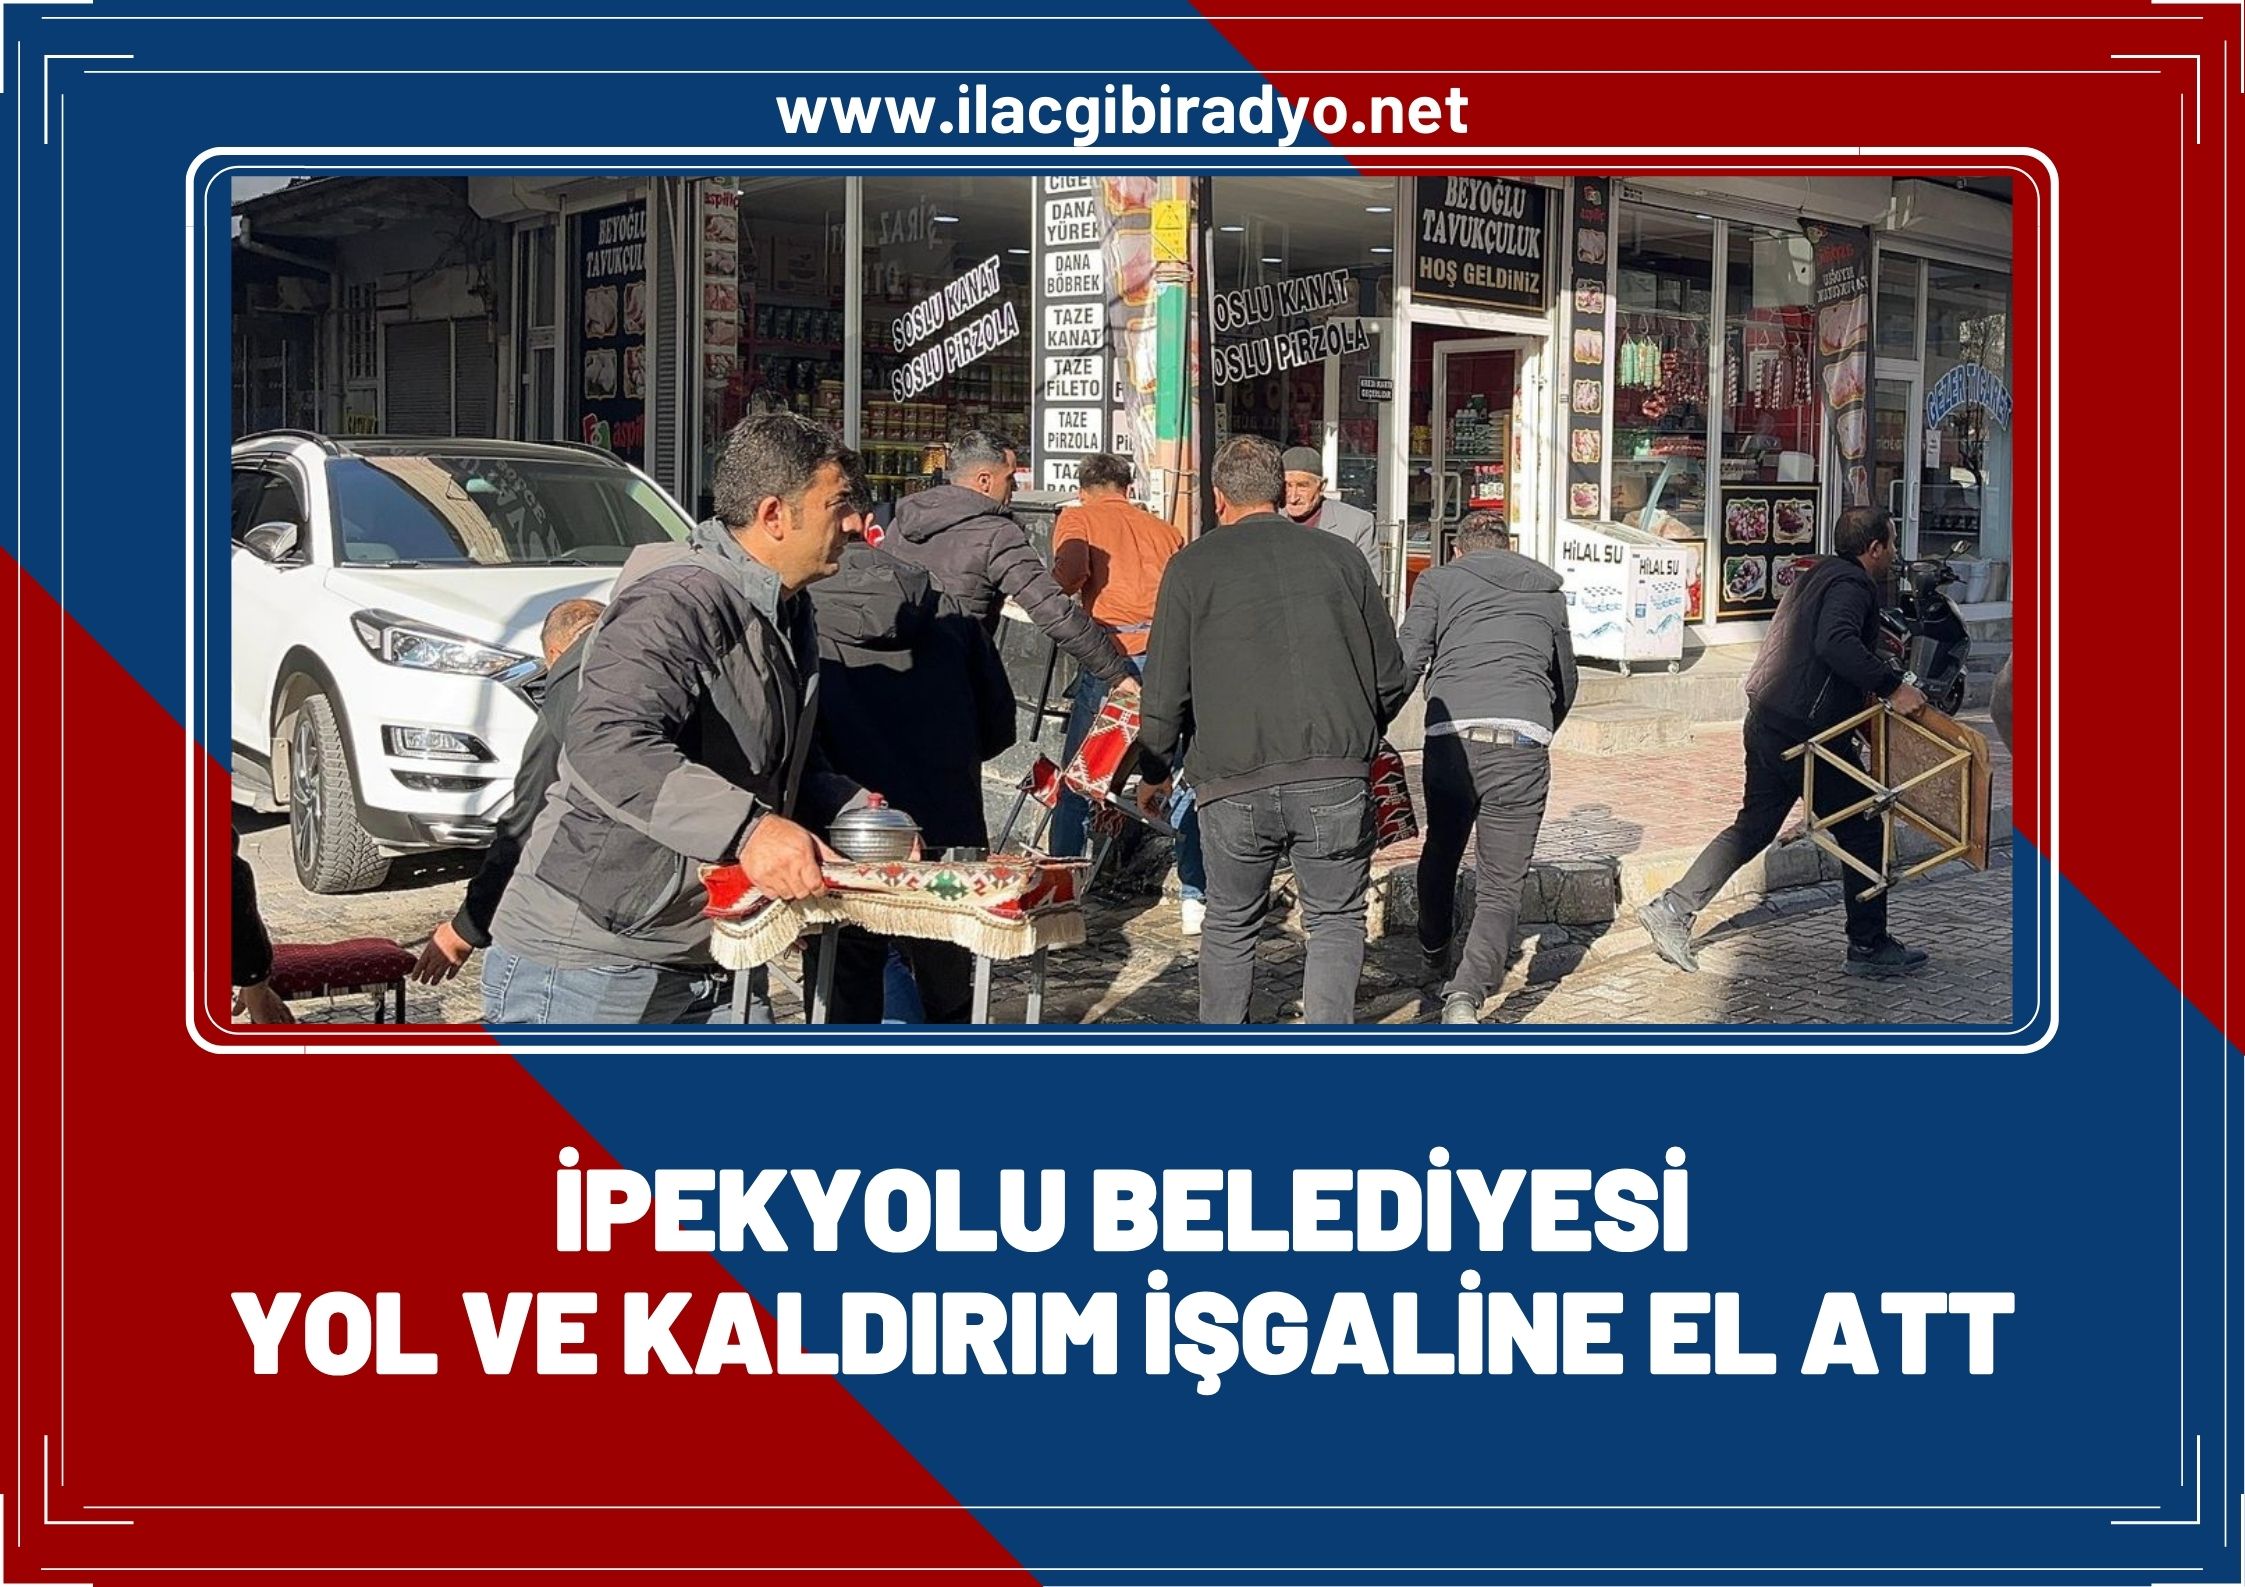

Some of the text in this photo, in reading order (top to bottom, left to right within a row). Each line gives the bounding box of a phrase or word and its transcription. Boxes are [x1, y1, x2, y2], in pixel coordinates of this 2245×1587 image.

[1445, 176, 1527, 219] BEYOĞLU
[1052, 201, 1095, 220] DANA
[1423, 208, 1540, 259] TAVUKÇULUK
[586, 243, 646, 279] TAVUKÇUL
[1056, 254, 1090, 272] DANA
[1420, 255, 1457, 288] HOŞ
[1047, 272, 1100, 293] BÖBREK
[892, 292, 945, 352] SOSLU
[944, 254, 1000, 320] KANAT
[1213, 268, 1349, 331] OSLU KANAT
[1053, 307, 1093, 325] TAZE
[1047, 328, 1101, 346] KANAT
[1054, 358, 1092, 375] TAZE
[1213, 338, 1271, 386] OSLU
[892, 344, 945, 402] SOSLU
[1926, 364, 1965, 429] GEZER
[1058, 411, 1088, 428] TAZE
[1053, 463, 1080, 480] TAZ
[1604, 545, 1624, 564] SU
[1667, 560, 1680, 575] SU
